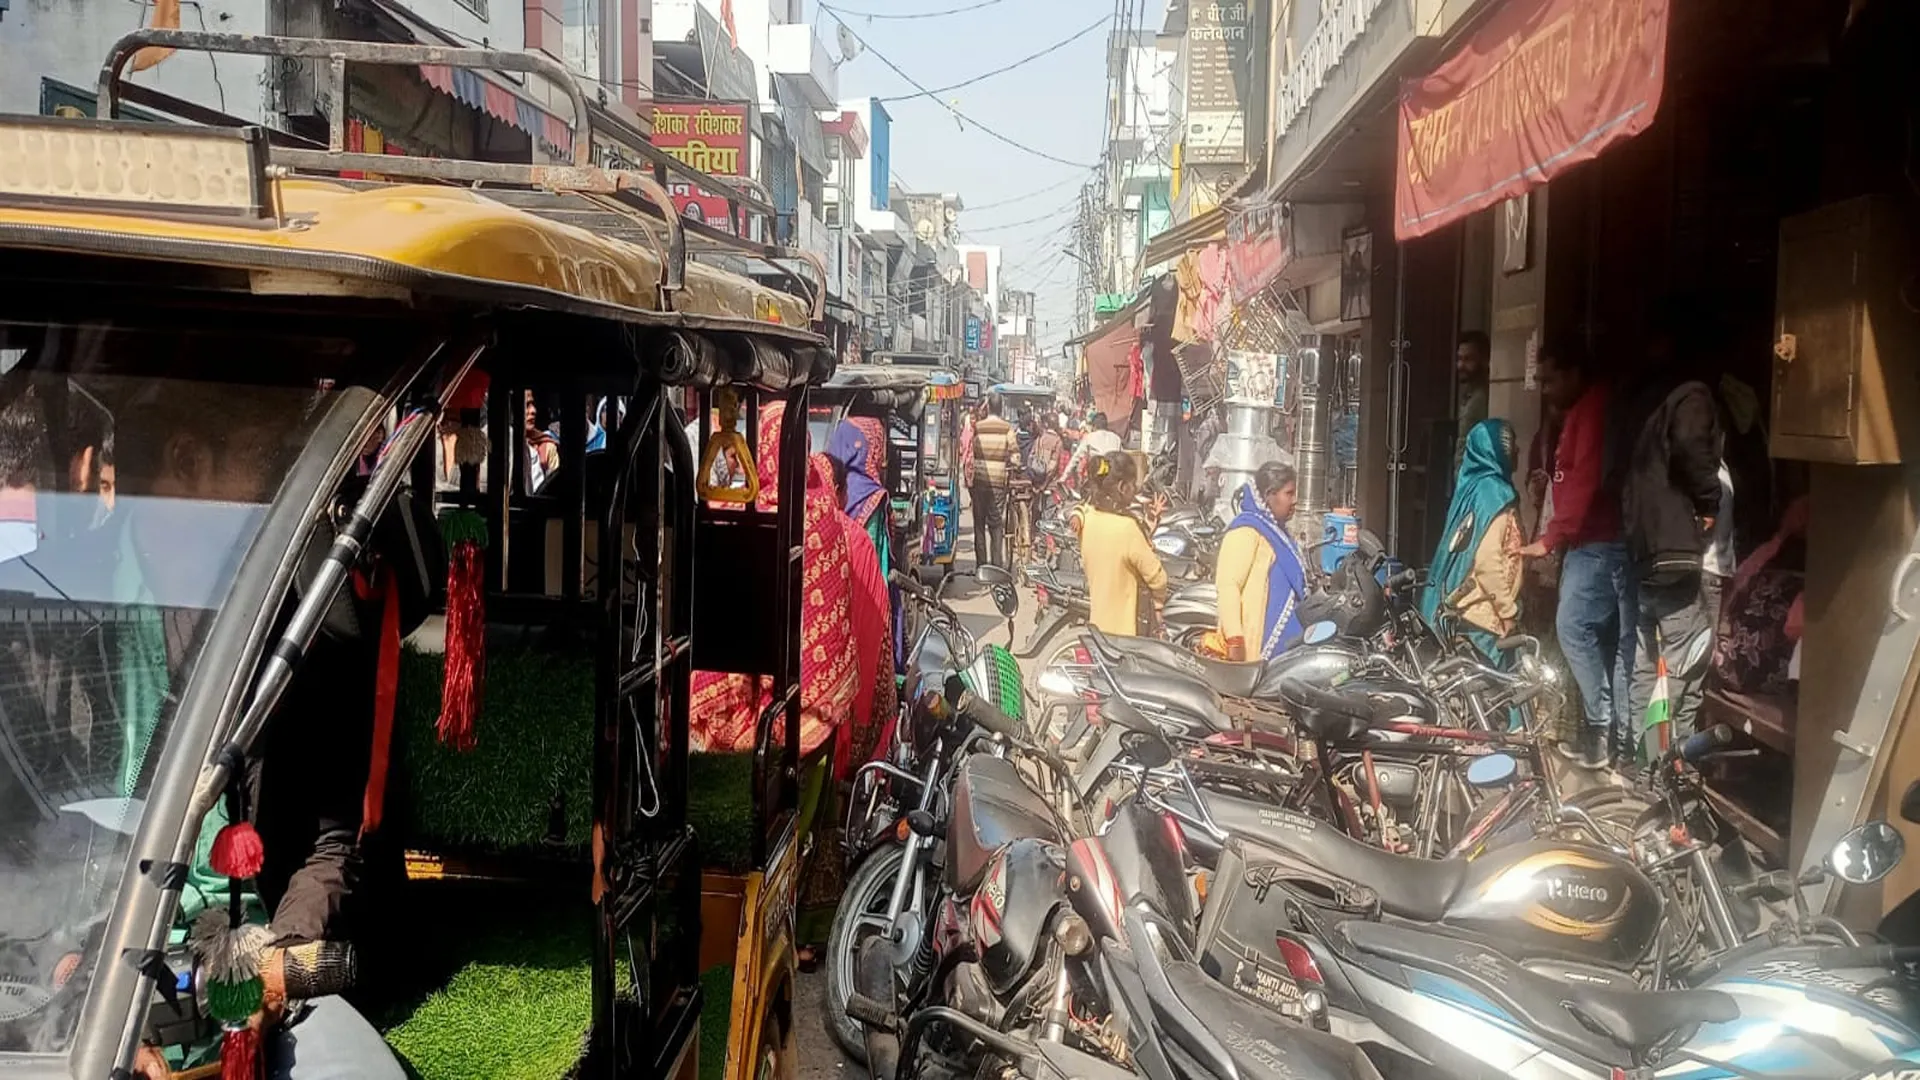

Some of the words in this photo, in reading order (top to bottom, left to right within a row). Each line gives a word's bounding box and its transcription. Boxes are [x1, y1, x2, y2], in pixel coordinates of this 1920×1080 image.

[1229, 3, 1245, 21] जी
[693, 108, 743, 135] रविशंकर
[1567, 883, 1608, 902] Hero
